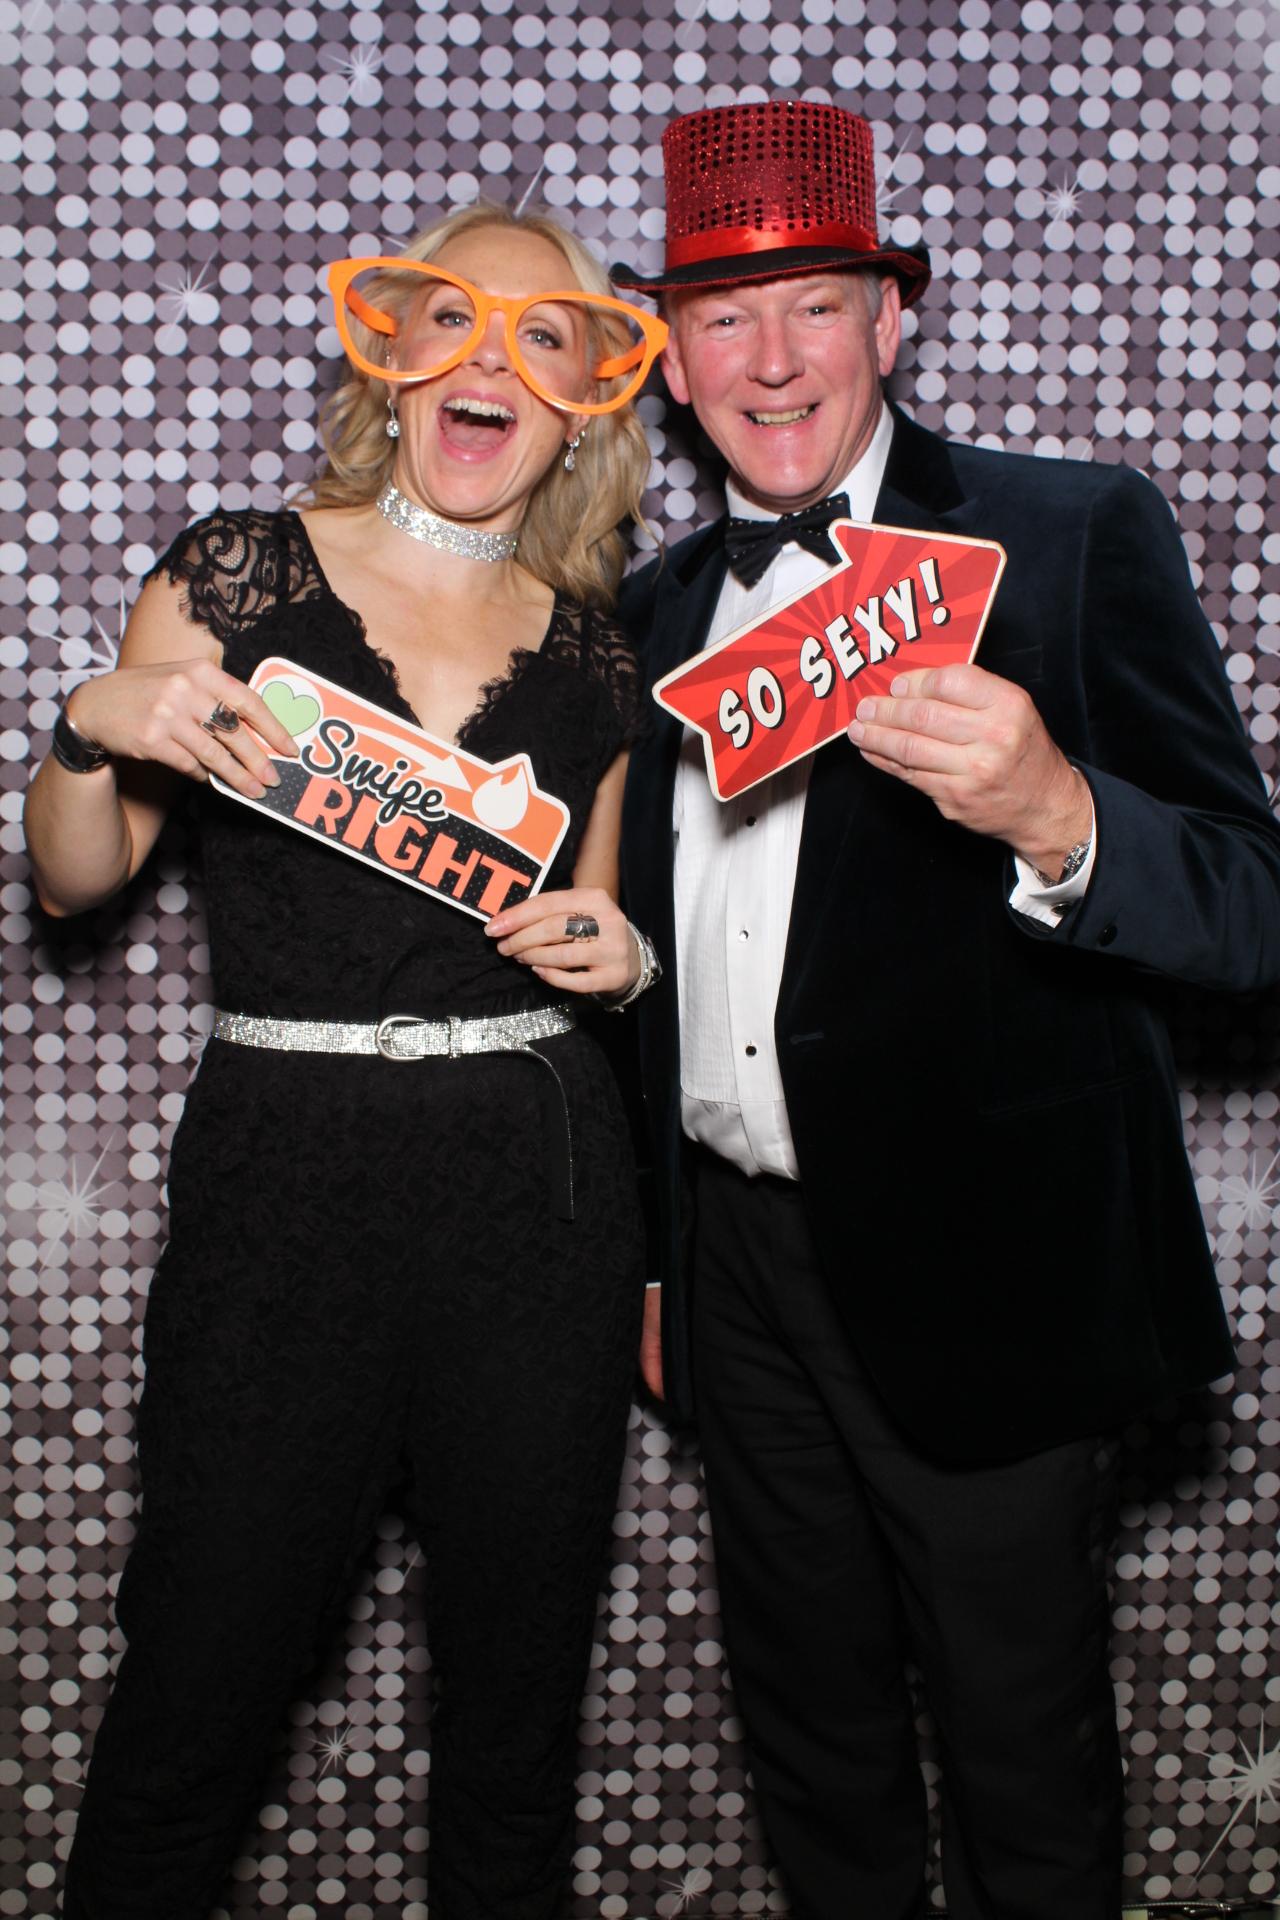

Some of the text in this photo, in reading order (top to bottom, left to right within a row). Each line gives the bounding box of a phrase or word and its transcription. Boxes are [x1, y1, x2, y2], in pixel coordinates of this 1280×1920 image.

[718, 557, 950, 749] SO SEXY!
[301, 718, 448, 825] Swipe
[293, 775, 531, 917] RIGHT
